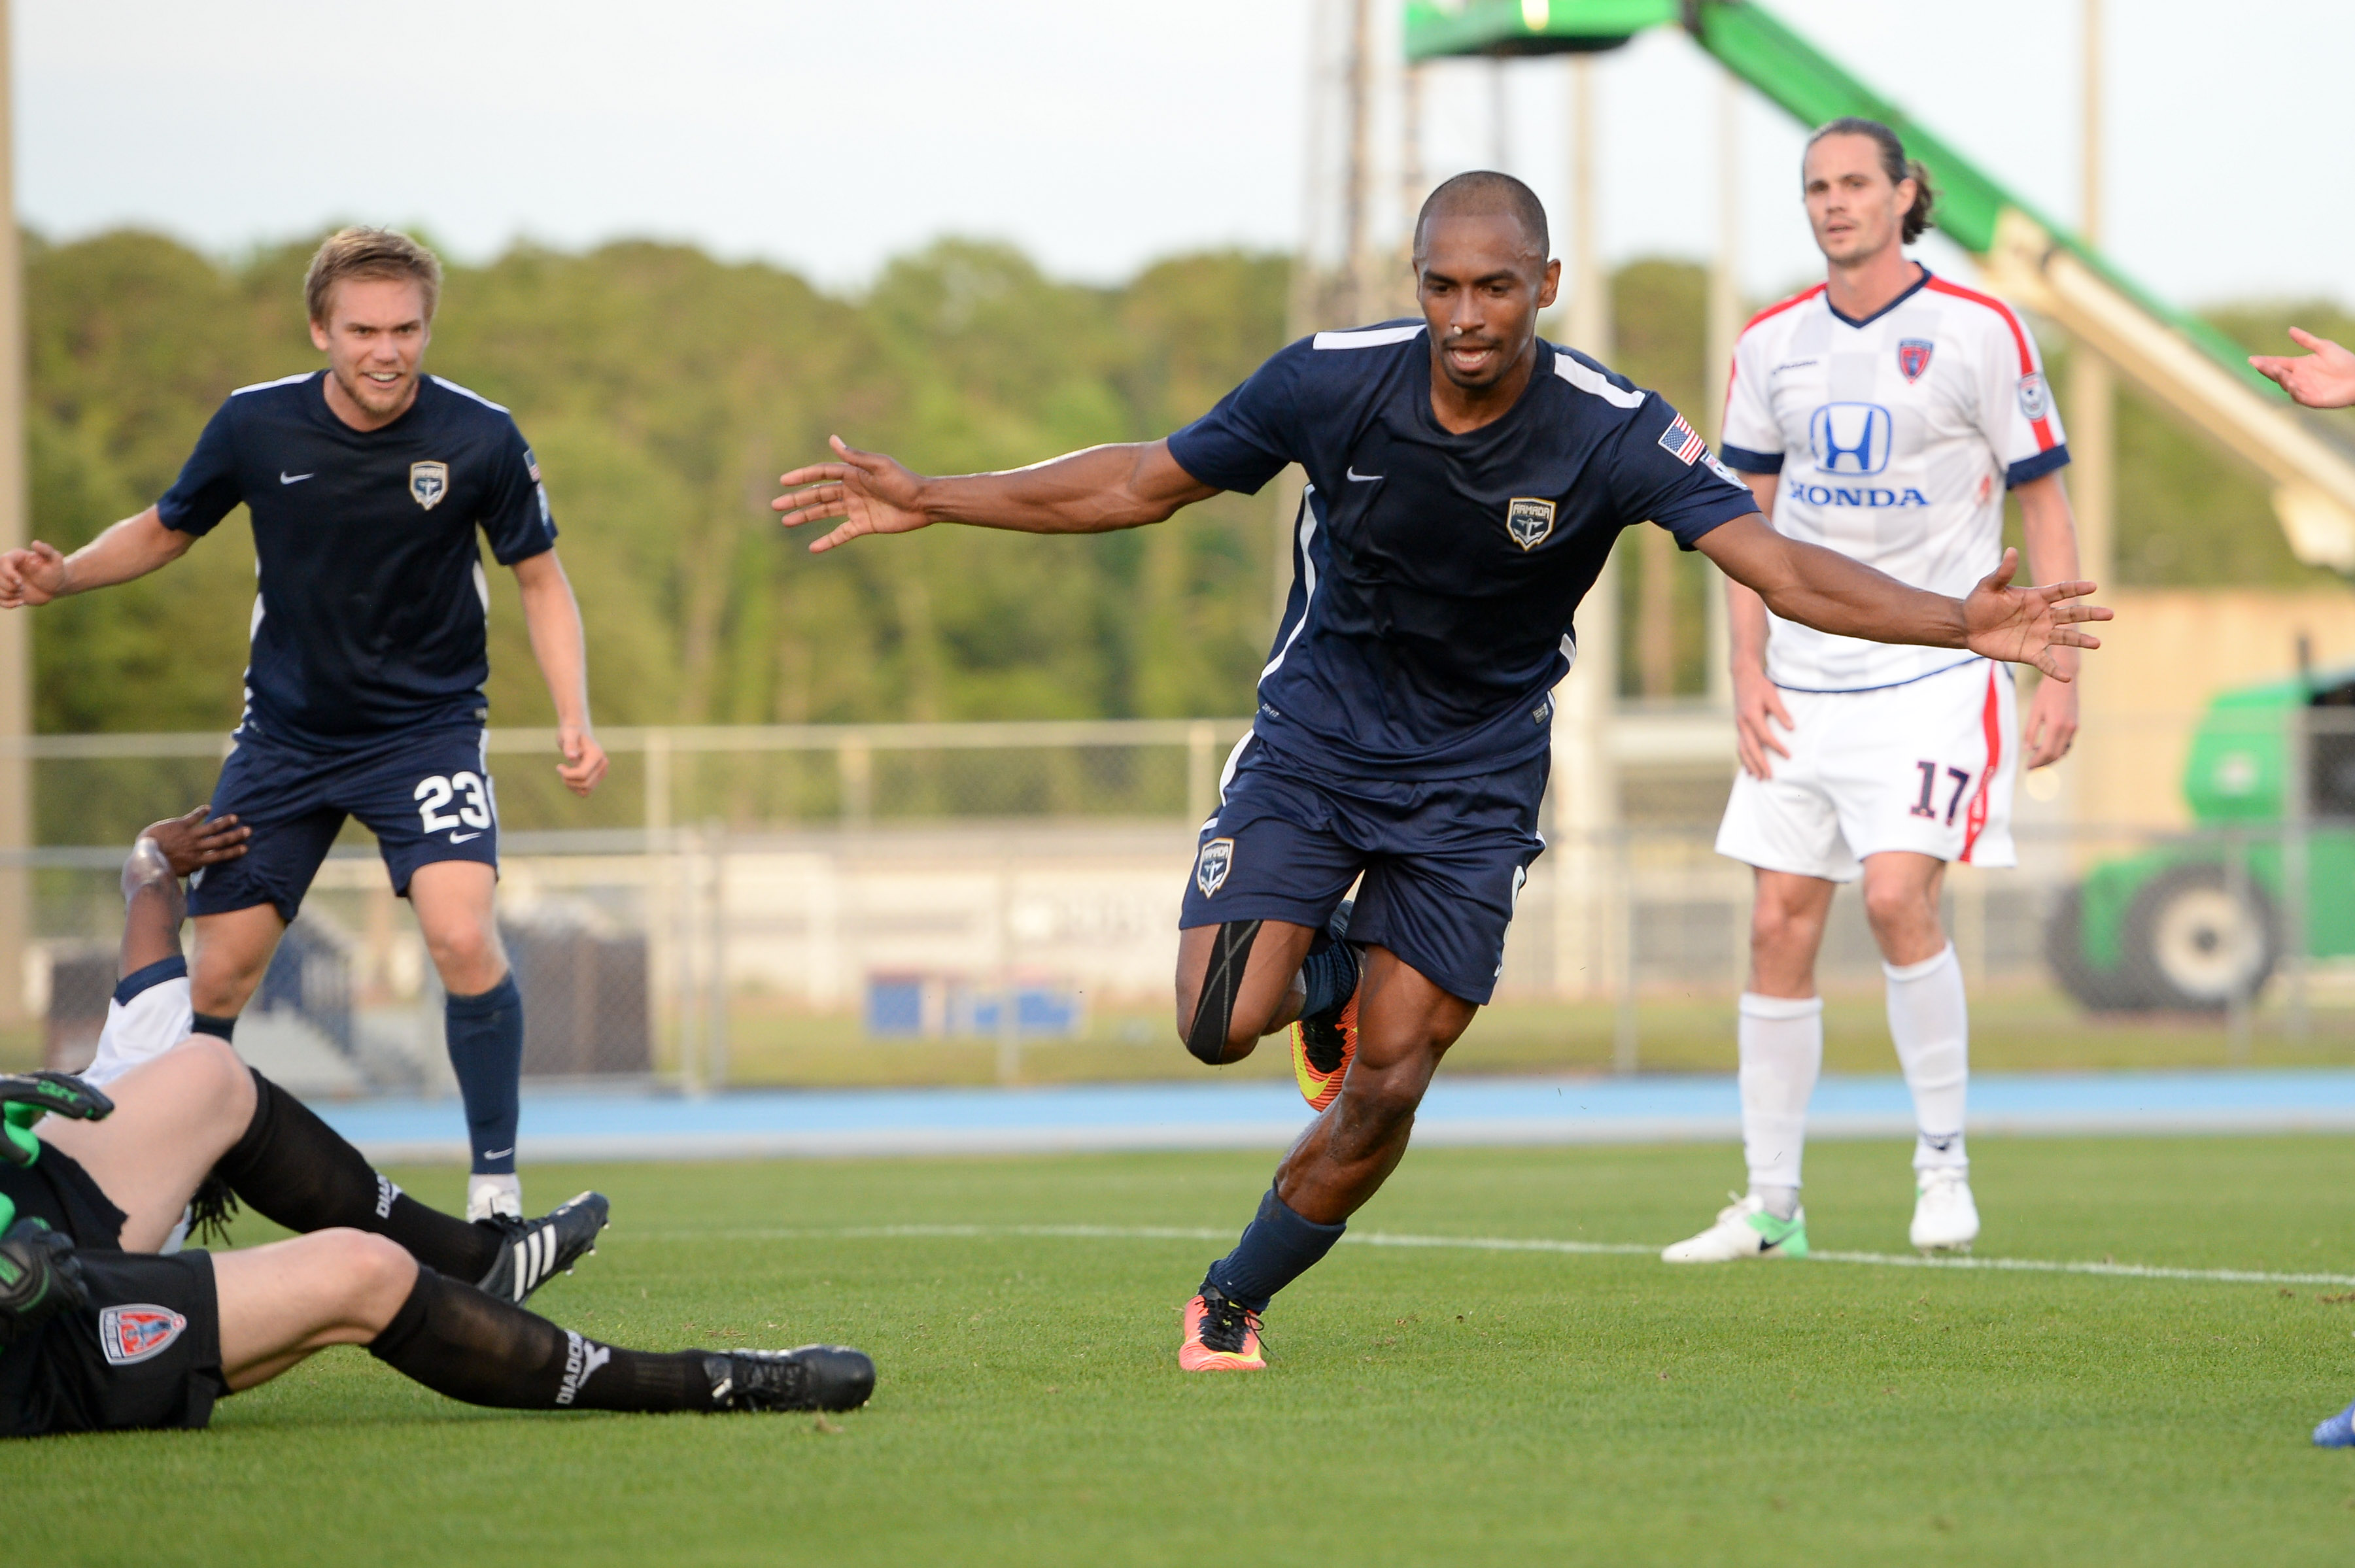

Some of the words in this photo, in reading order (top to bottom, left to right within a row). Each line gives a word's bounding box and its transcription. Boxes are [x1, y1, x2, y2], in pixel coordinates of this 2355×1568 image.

[1513, 502, 1551, 521] ARMADA
[414, 770, 492, 834] 23
[1909, 761, 1970, 827] 17
